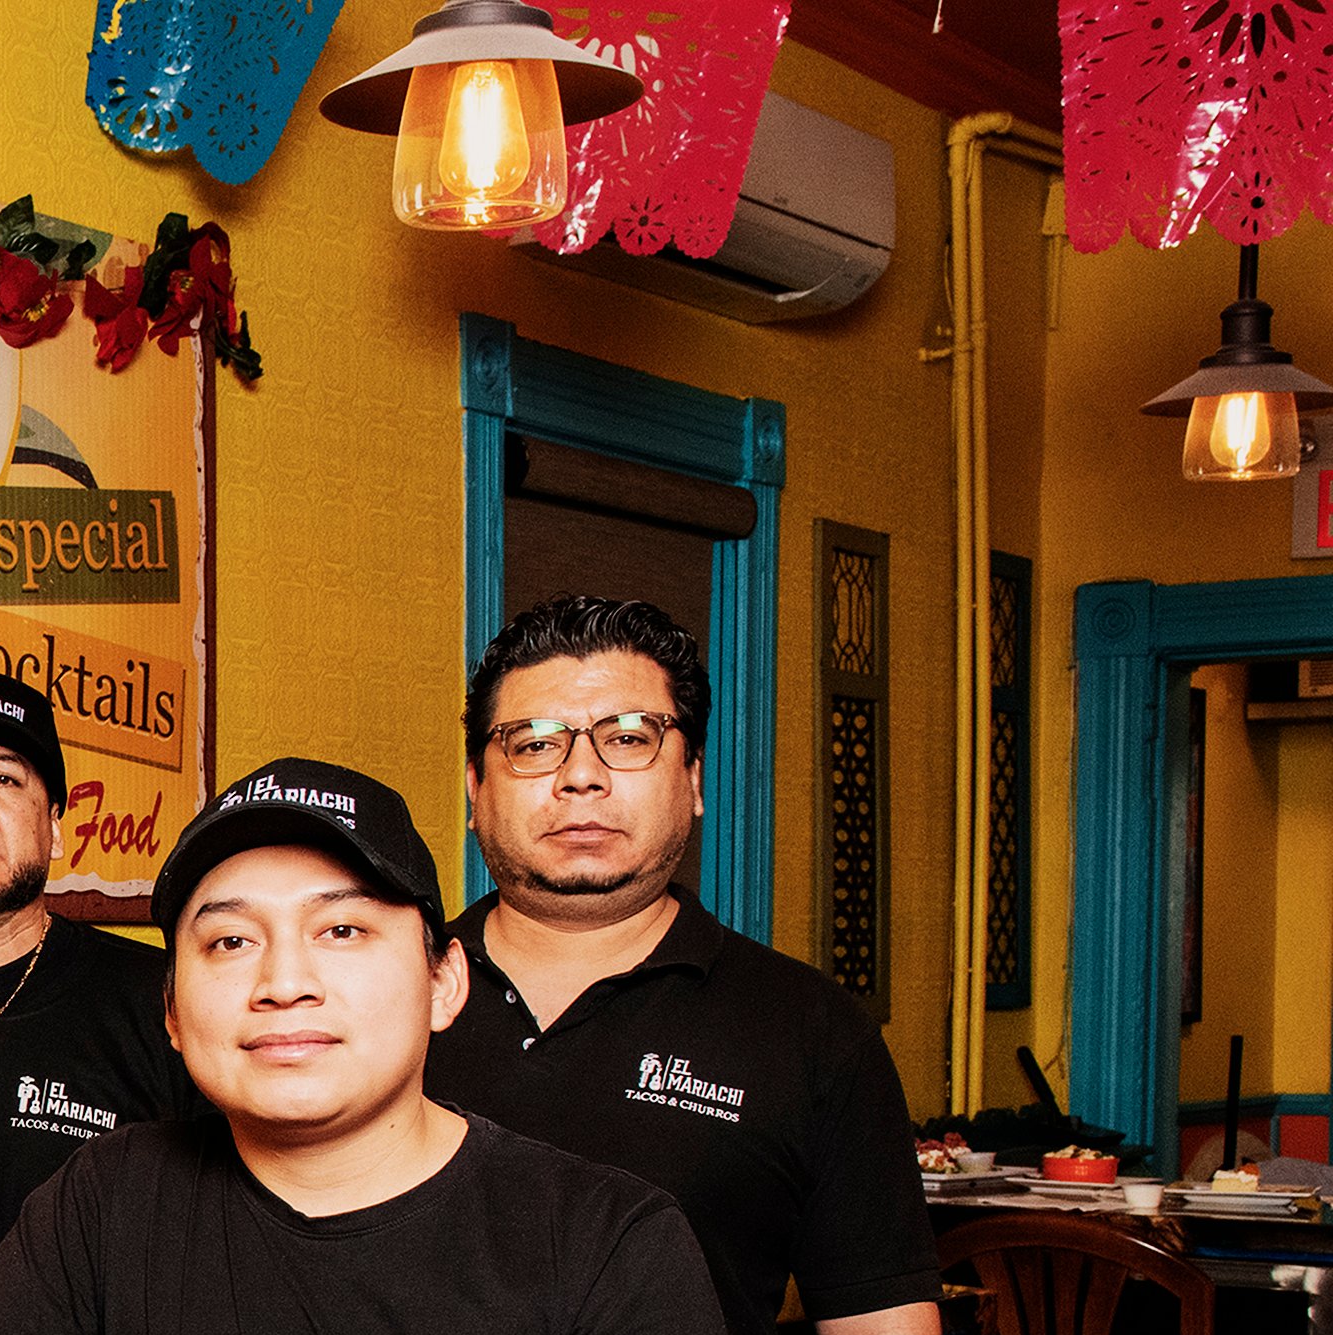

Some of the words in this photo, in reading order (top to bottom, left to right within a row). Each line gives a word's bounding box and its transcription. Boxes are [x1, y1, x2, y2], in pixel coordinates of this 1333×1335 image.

[253, 774, 280, 795] EL
[67, 780, 163, 869] Food
[670, 1058, 692, 1076] EL
[49, 1082, 68, 1100] EL
[665, 1073, 745, 1107] MARIACHI
[45, 1098, 117, 1130] MARIACHI
[624, 1089, 667, 1105] TACOS
[667, 1097, 678, 1107] &
[679, 1099, 740, 1123] CHURROS
[10, 1117, 49, 1131] TACOS
[49, 1122, 60, 1133] &
